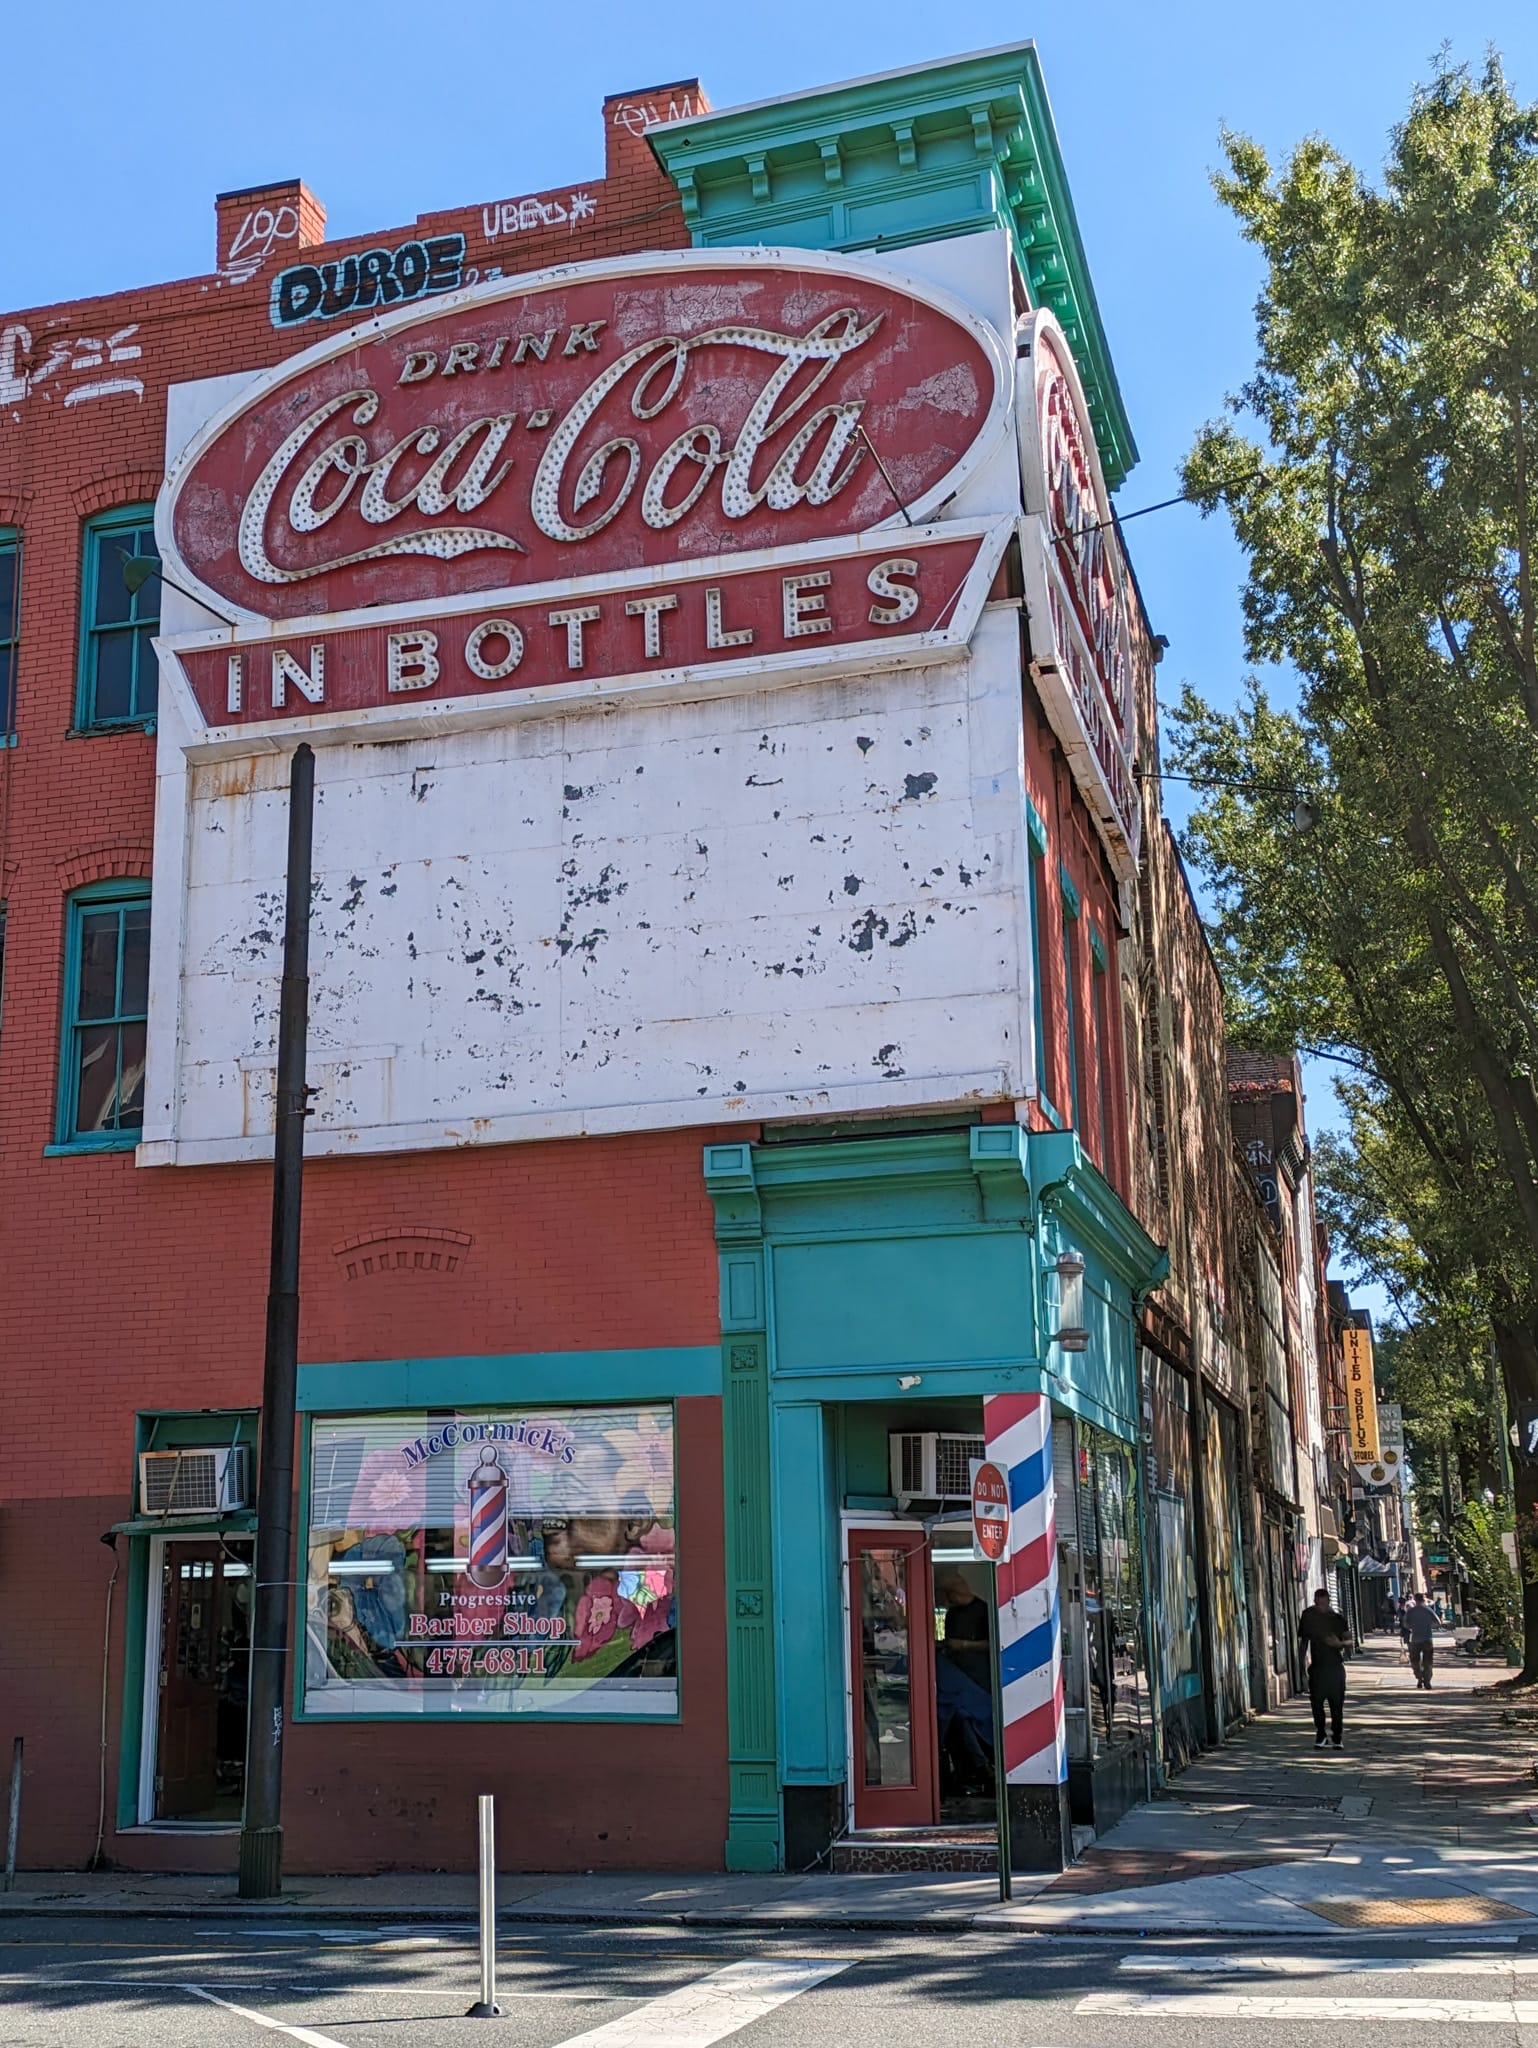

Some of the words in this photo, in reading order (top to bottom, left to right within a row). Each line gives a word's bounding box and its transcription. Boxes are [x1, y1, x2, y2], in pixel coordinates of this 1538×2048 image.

[400, 320, 607, 384] DRINK
[238, 307, 884, 583] Coca-Cola
[227, 643, 326, 713] IN
[387, 558, 920, 693] BOTTLES
[1349, 1331, 1362, 1381] UNITED
[1354, 1388, 1366, 1448] SURPLUS
[401, 1420, 577, 1470] McCormick's
[1353, 1450, 1375, 1461] STORES
[977, 1482, 987, 1496] DO
[991, 1483, 1004, 1498] NOT
[982, 1524, 1003, 1539] ENTER
[439, 1591, 537, 1609] Progressive
[409, 1613, 497, 1636] Barber
[503, 1612, 567, 1639] Shop
[426, 1647, 548, 1675] 477-6811
